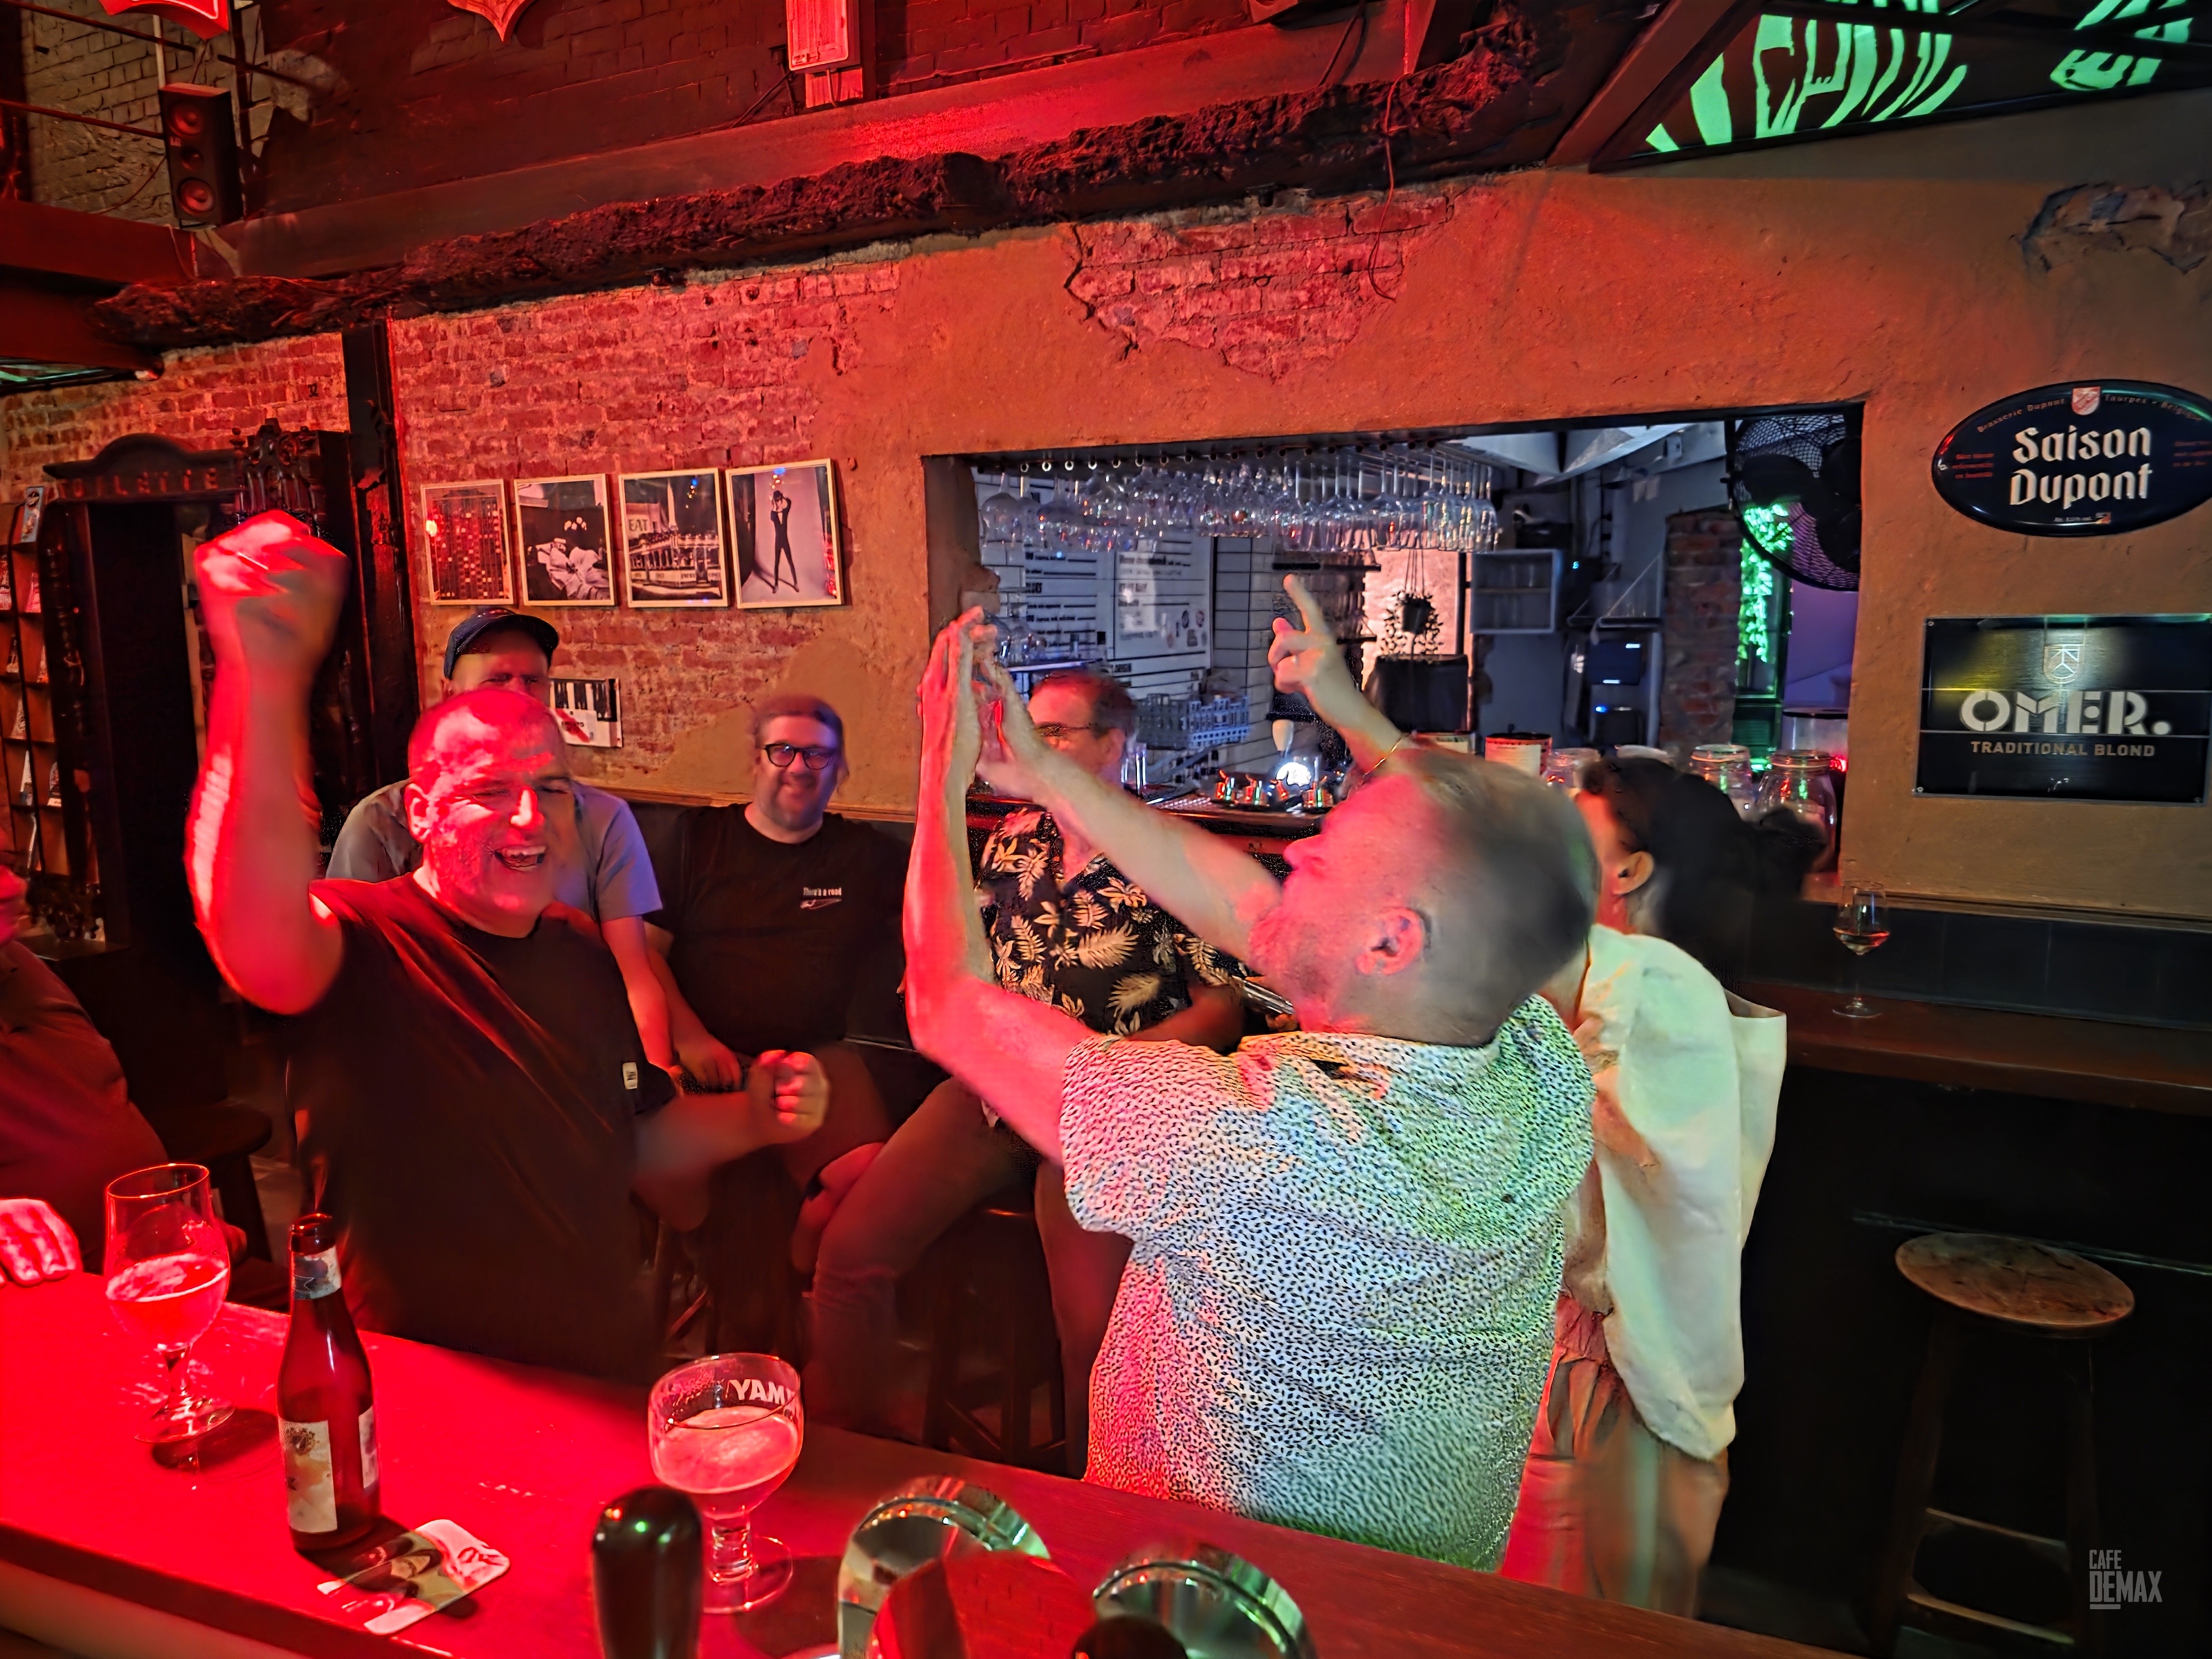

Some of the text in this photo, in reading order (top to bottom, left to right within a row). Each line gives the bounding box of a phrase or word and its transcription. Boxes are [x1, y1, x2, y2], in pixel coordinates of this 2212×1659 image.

[2012, 425, 2151, 463] Saison
[2010, 463, 2153, 510] Dupont
[628, 519, 648, 531] EAT
[1970, 740, 2155, 757] TRADITIONAL BLOND
